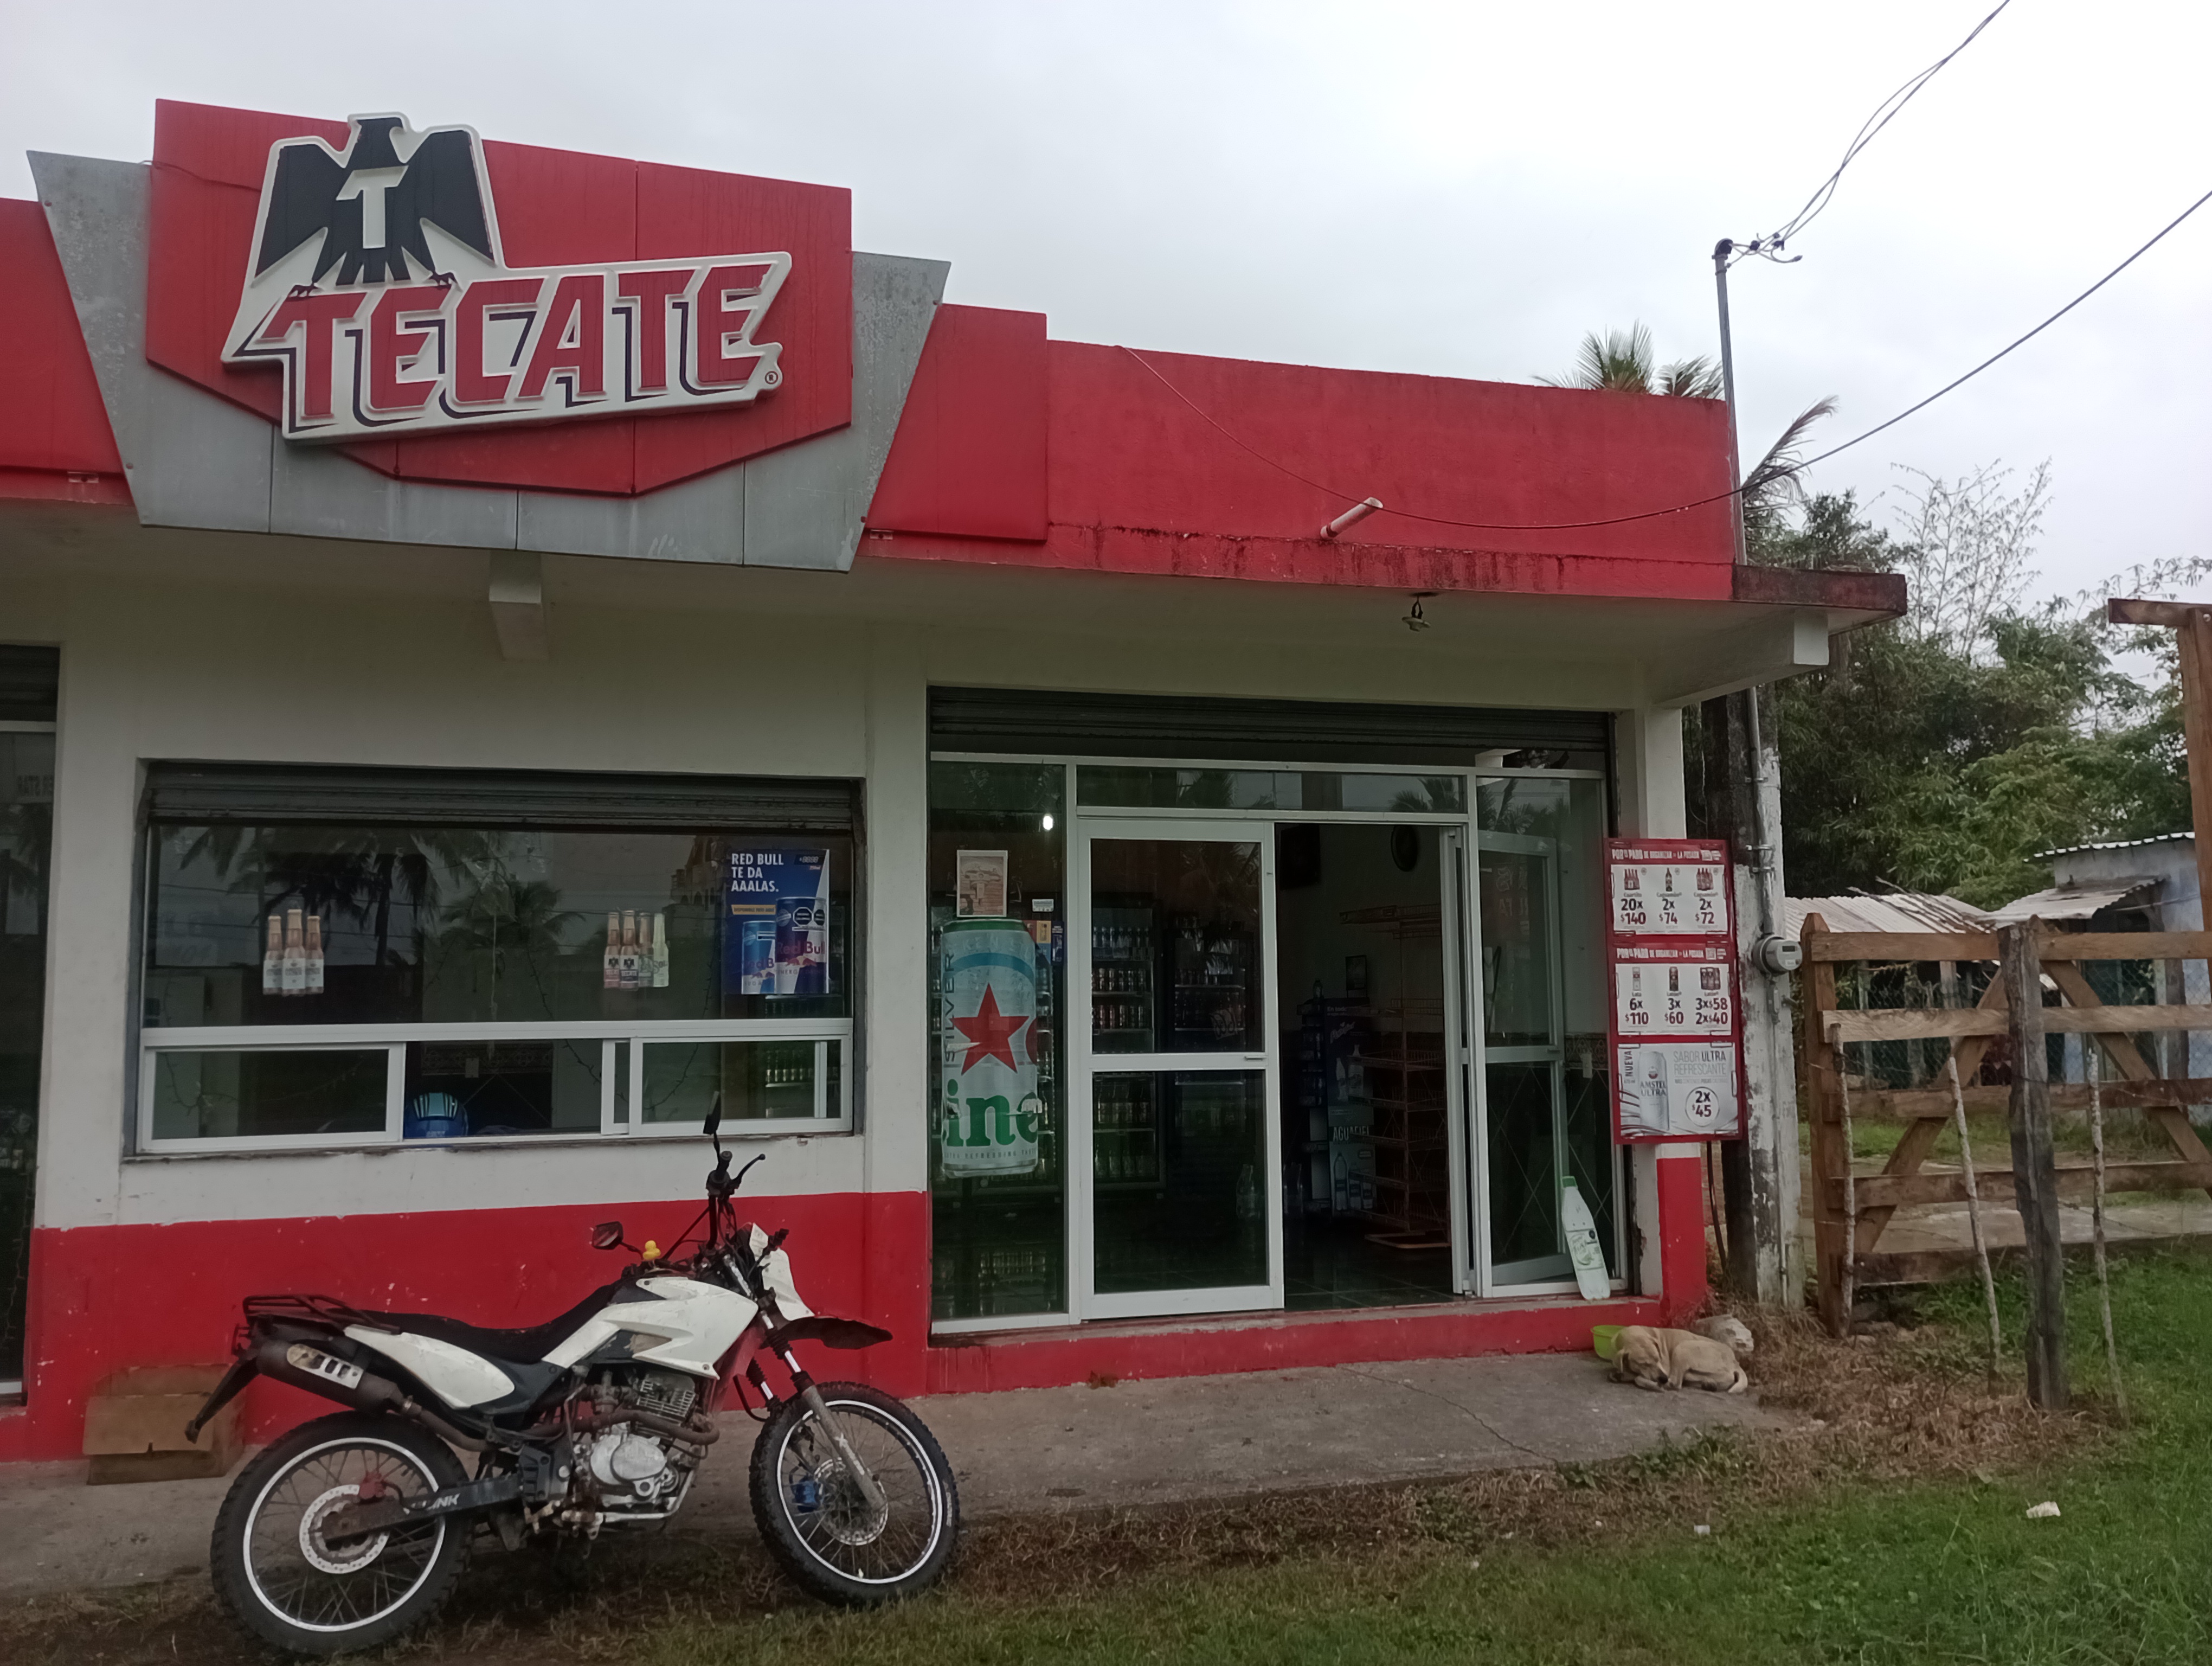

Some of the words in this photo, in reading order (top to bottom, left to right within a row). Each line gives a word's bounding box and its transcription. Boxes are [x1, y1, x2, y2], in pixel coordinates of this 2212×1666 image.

[256, 263, 777, 422] TECATE
[731, 853, 754, 866] RED
[757, 853, 785, 866] BULL
[731, 866, 744, 879] TE
[747, 867, 763, 879] DA
[731, 880, 780, 893] AAALAS.
[1621, 898, 1644, 911] 20x
[1662, 898, 1675, 911] 2x
[1699, 898, 1713, 911] 2x
[1621, 912, 1647, 925] $140
[1658, 912, 1678, 925] $74
[1695, 912, 1715, 924] $72
[944, 953, 955, 1062] SILVER
[1629, 997, 1643, 1011] 6x
[1668, 997, 1681, 1010] 3x
[1625, 1011, 1649, 1025] $110
[1664, 1011, 1684, 1024] $60
[1673, 1050, 1701, 1062] SABOR
[1702, 1050, 1726, 1062] ULTRA
[1624, 1050, 1634, 1077] NUEVA
[1674, 1063, 1726, 1075] REFRESCANTE
[1640, 1080, 1667, 1089] AMSTEL
[1641, 1088, 1667, 1097] ULTRA
[1692, 1105, 1712, 1118] $45
